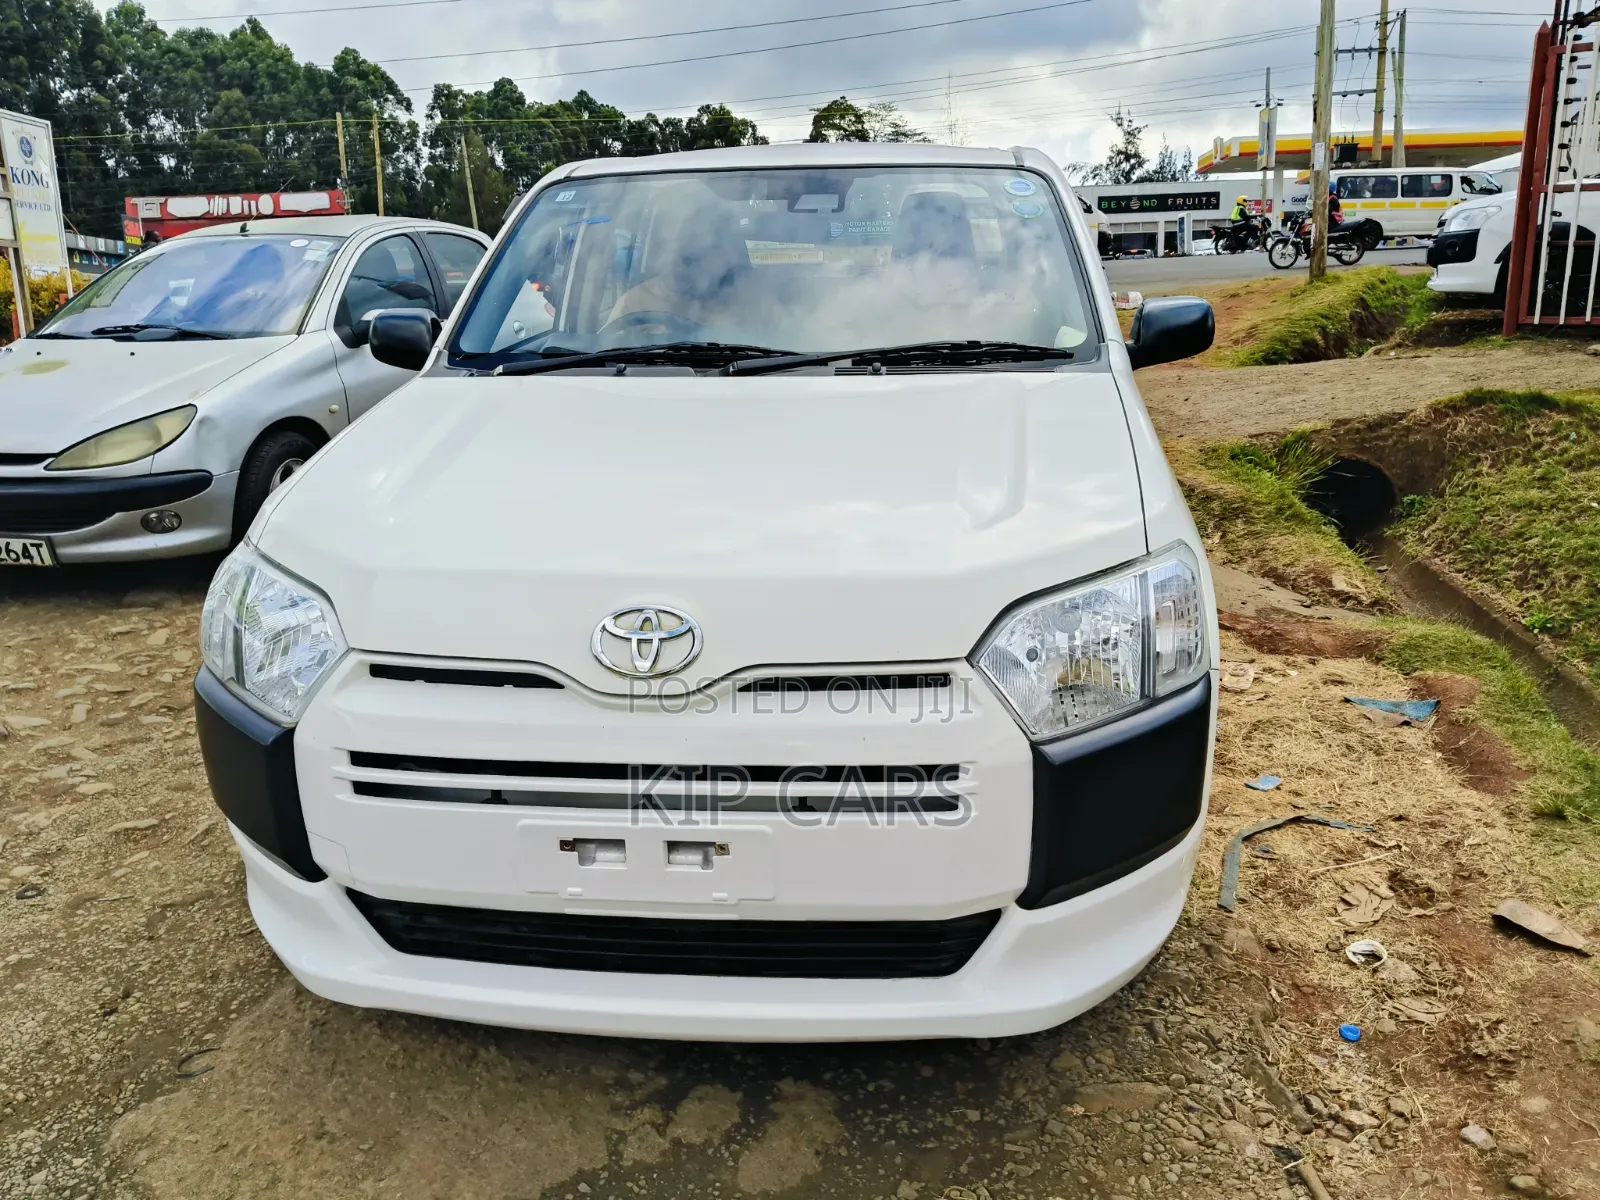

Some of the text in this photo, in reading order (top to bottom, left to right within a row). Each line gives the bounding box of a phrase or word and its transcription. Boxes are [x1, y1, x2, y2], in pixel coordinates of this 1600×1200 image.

[10, 166, 49, 188] KONG
[15, 200, 37, 210] ERVICE
[1101, 197, 1217, 209] BEYOND FRUITS
